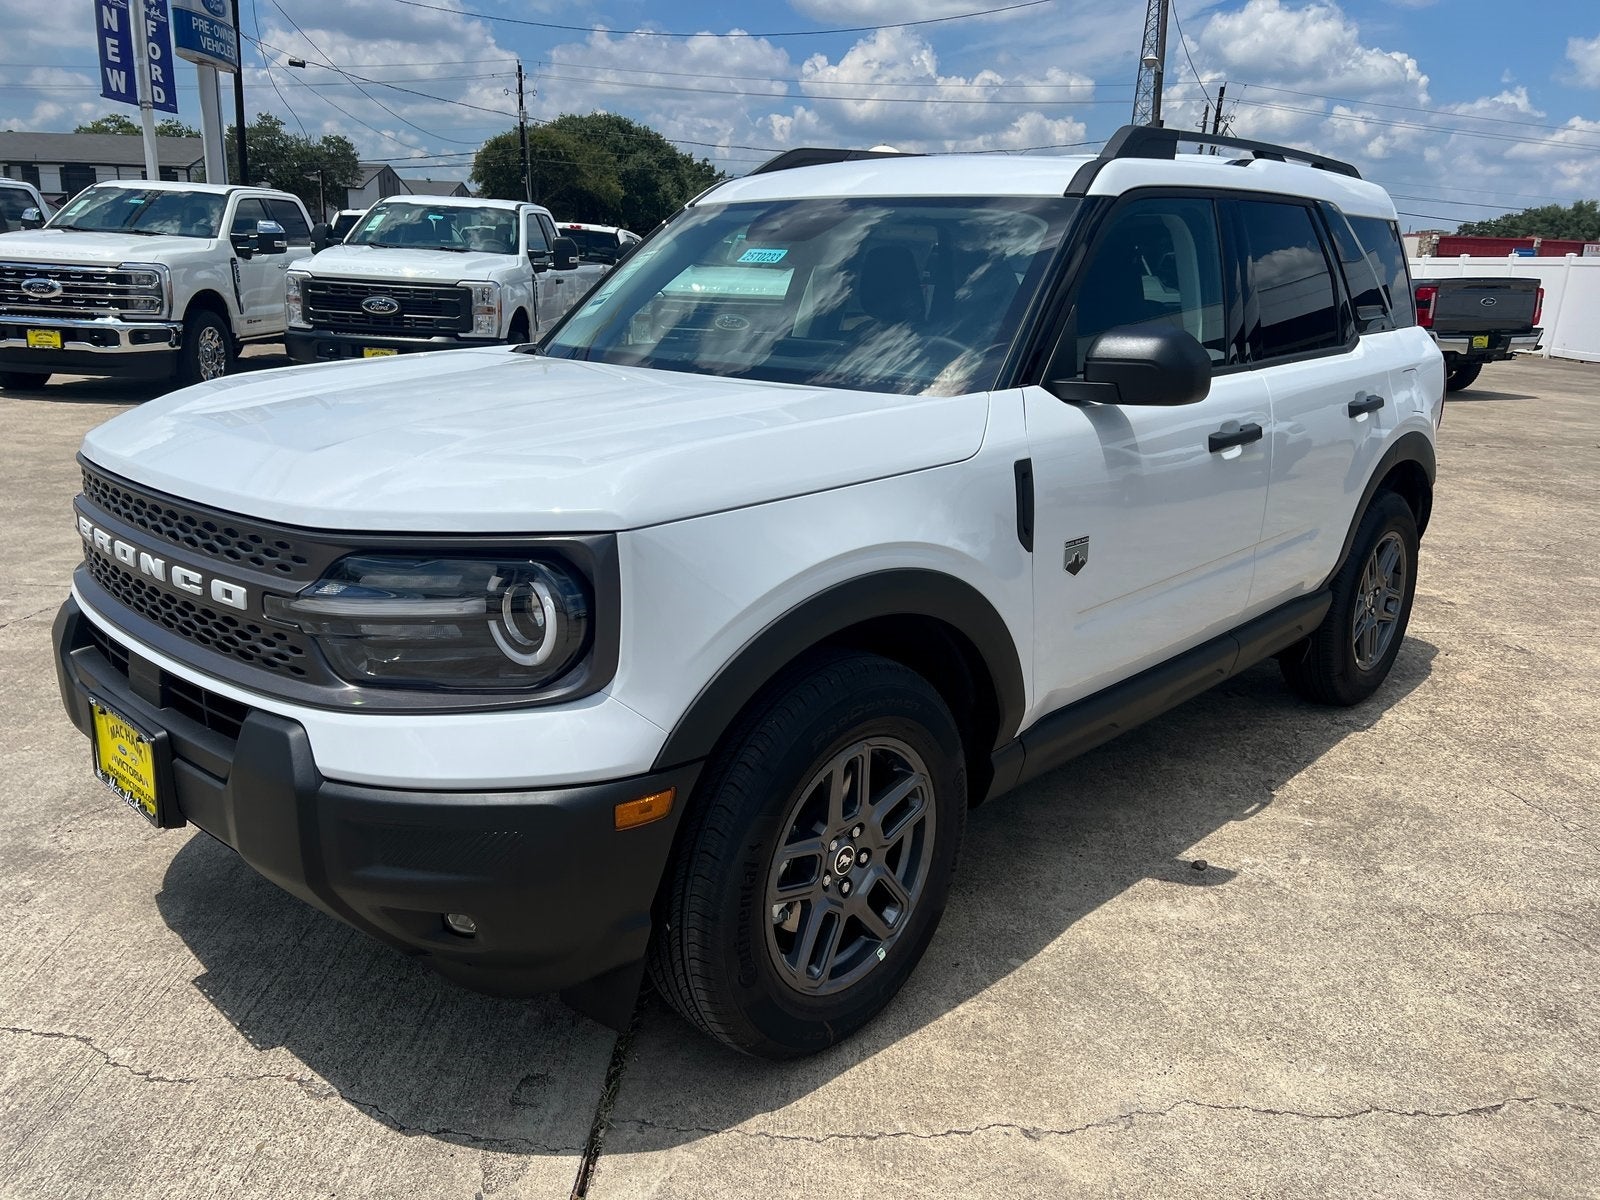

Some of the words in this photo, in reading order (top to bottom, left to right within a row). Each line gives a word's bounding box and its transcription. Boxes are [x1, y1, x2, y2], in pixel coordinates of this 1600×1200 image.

[102, 5, 126, 94] NEW
[146, 19, 166, 104] FORD
[370, 301, 389, 311] Ford
[79, 516, 248, 610] BRONCO
[110, 724, 125, 741] MAC
[124, 791, 140, 809] Haik
